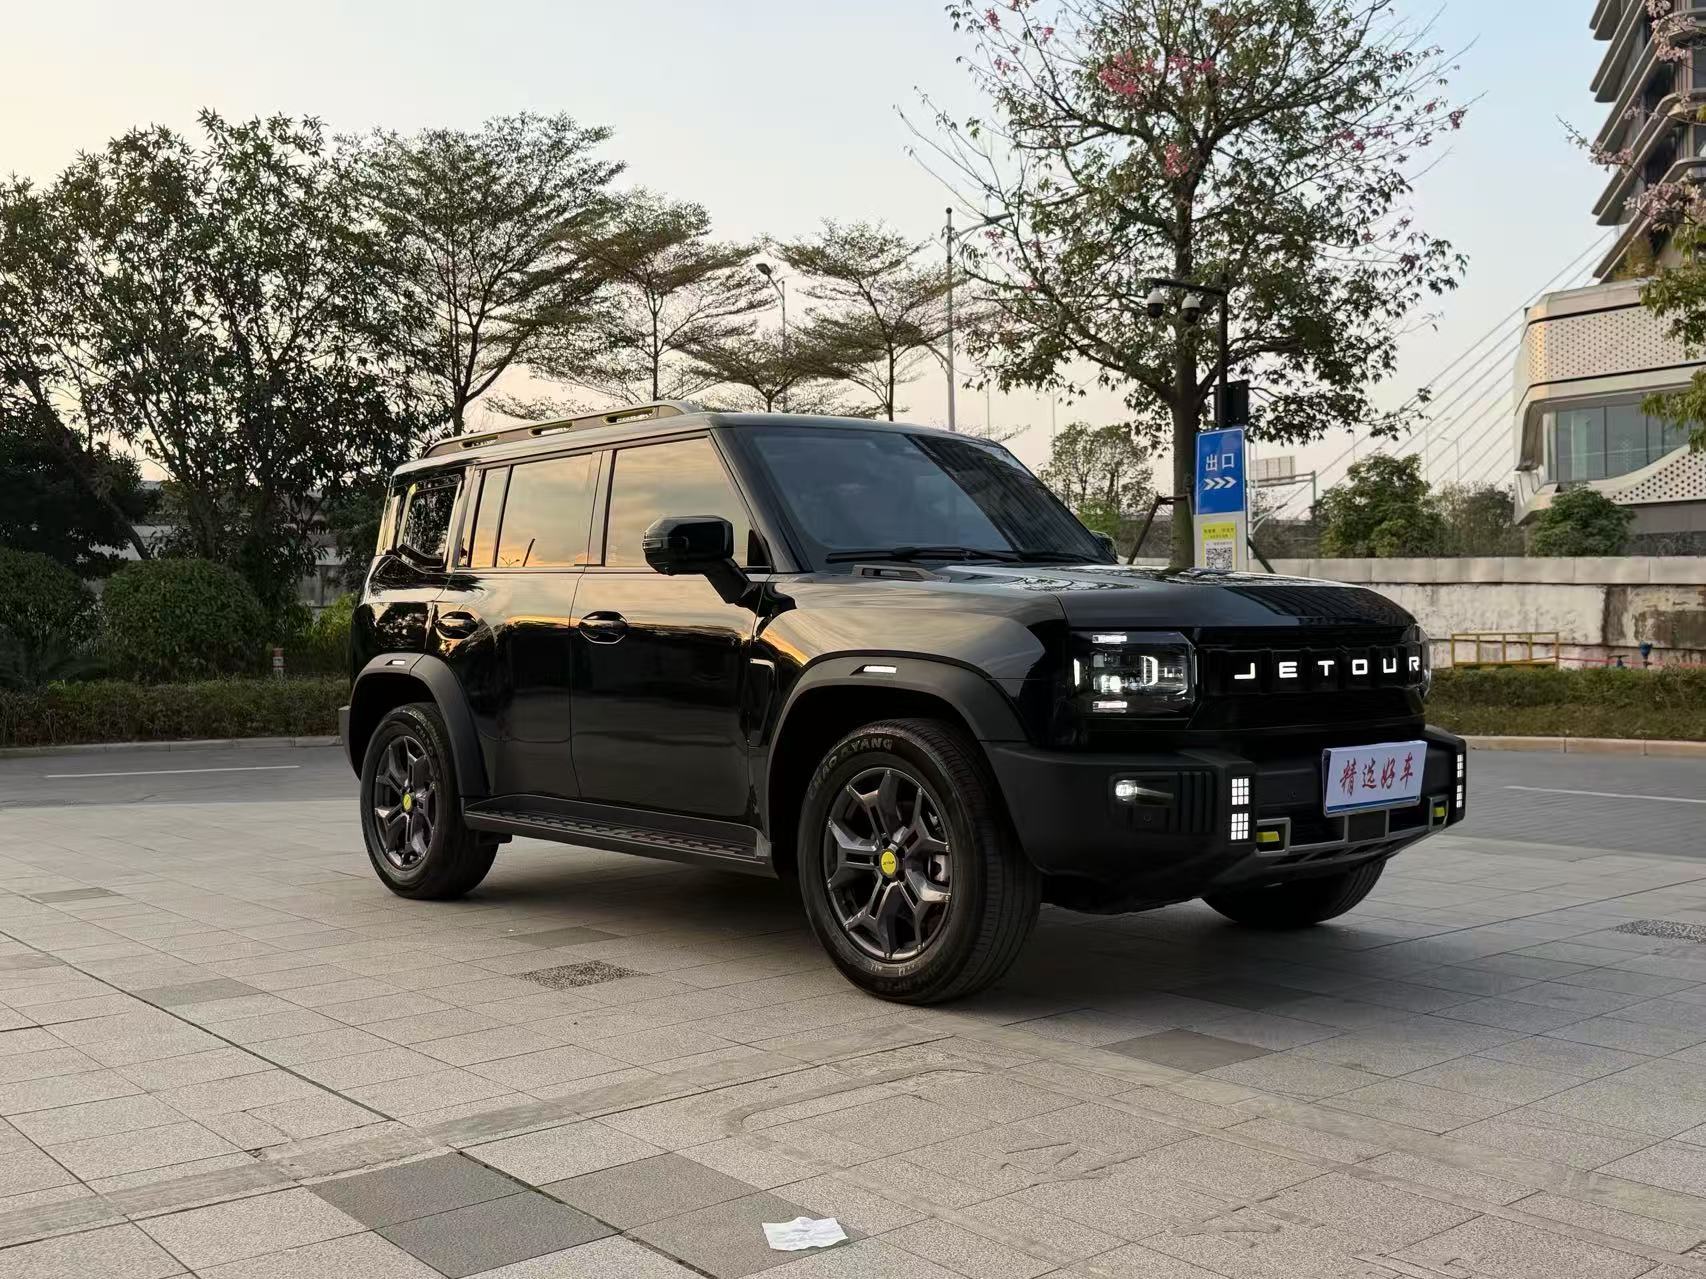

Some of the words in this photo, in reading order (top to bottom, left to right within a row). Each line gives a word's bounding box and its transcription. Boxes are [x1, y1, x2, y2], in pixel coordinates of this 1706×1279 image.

[1206, 454, 1234, 471] 出口
[1233, 656, 1420, 680] JETOUR
[1339, 751, 1414, 797] 精选好车
